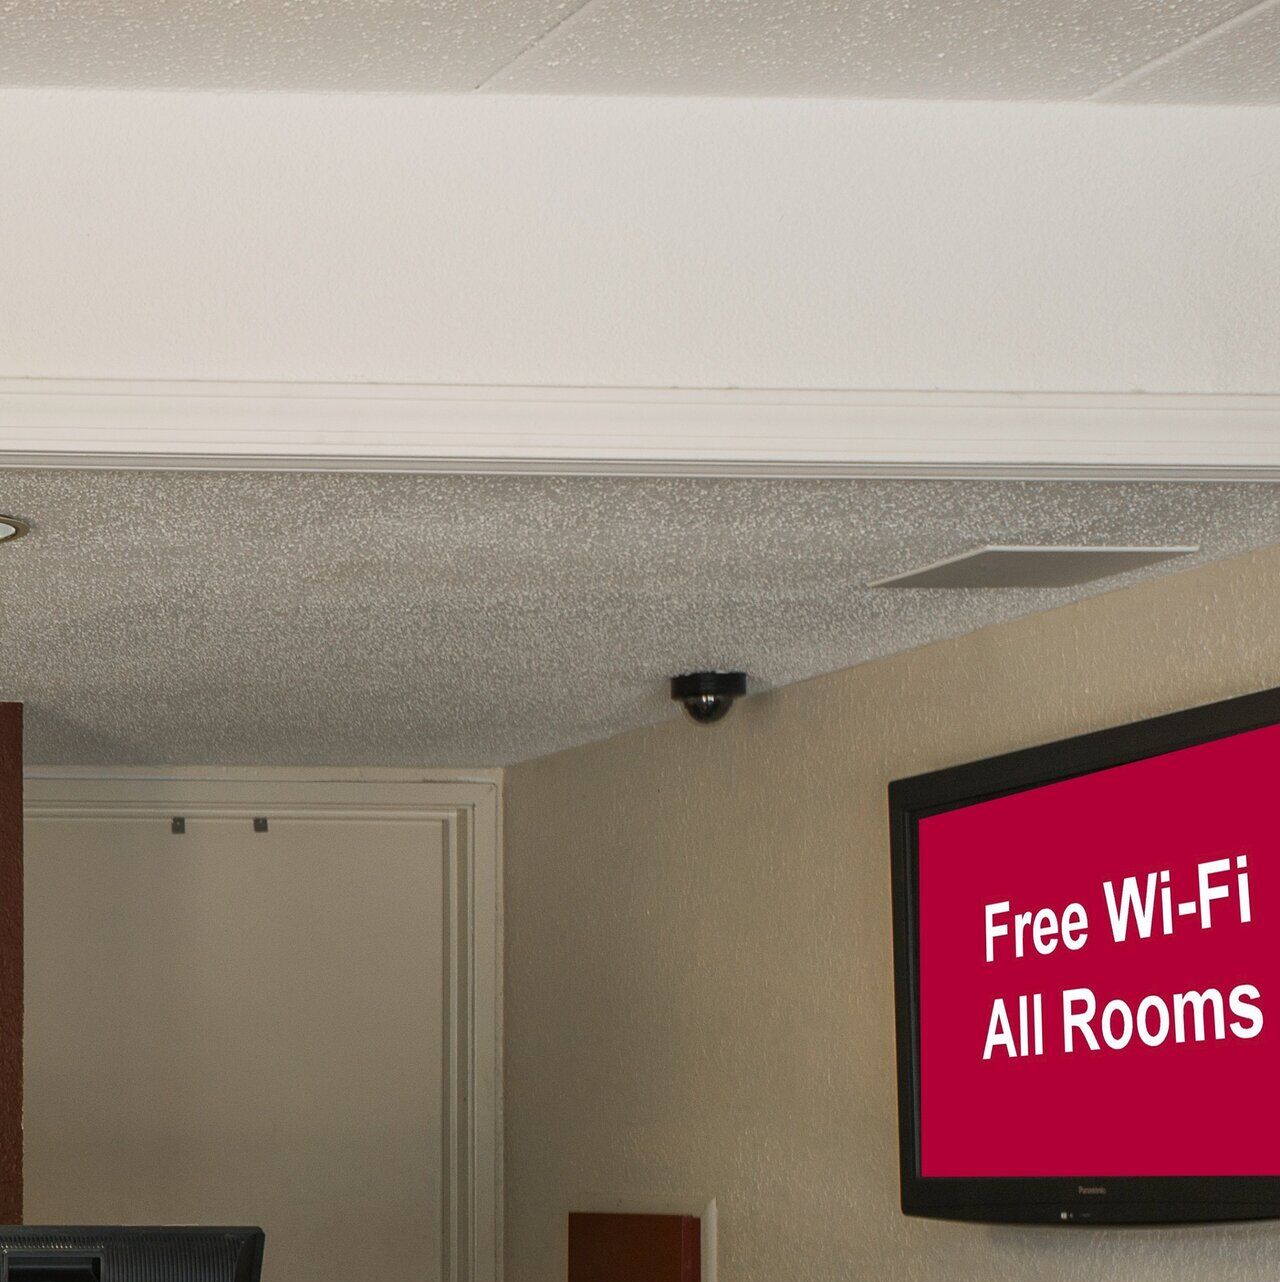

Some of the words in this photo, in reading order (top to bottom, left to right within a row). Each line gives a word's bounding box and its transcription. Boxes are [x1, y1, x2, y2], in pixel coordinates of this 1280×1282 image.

[984, 901, 1088, 962] Free
[1103, 855, 1252, 943] Wi-Fi
[982, 993, 1044, 1060] All
[1063, 983, 1264, 1053] Rooms
